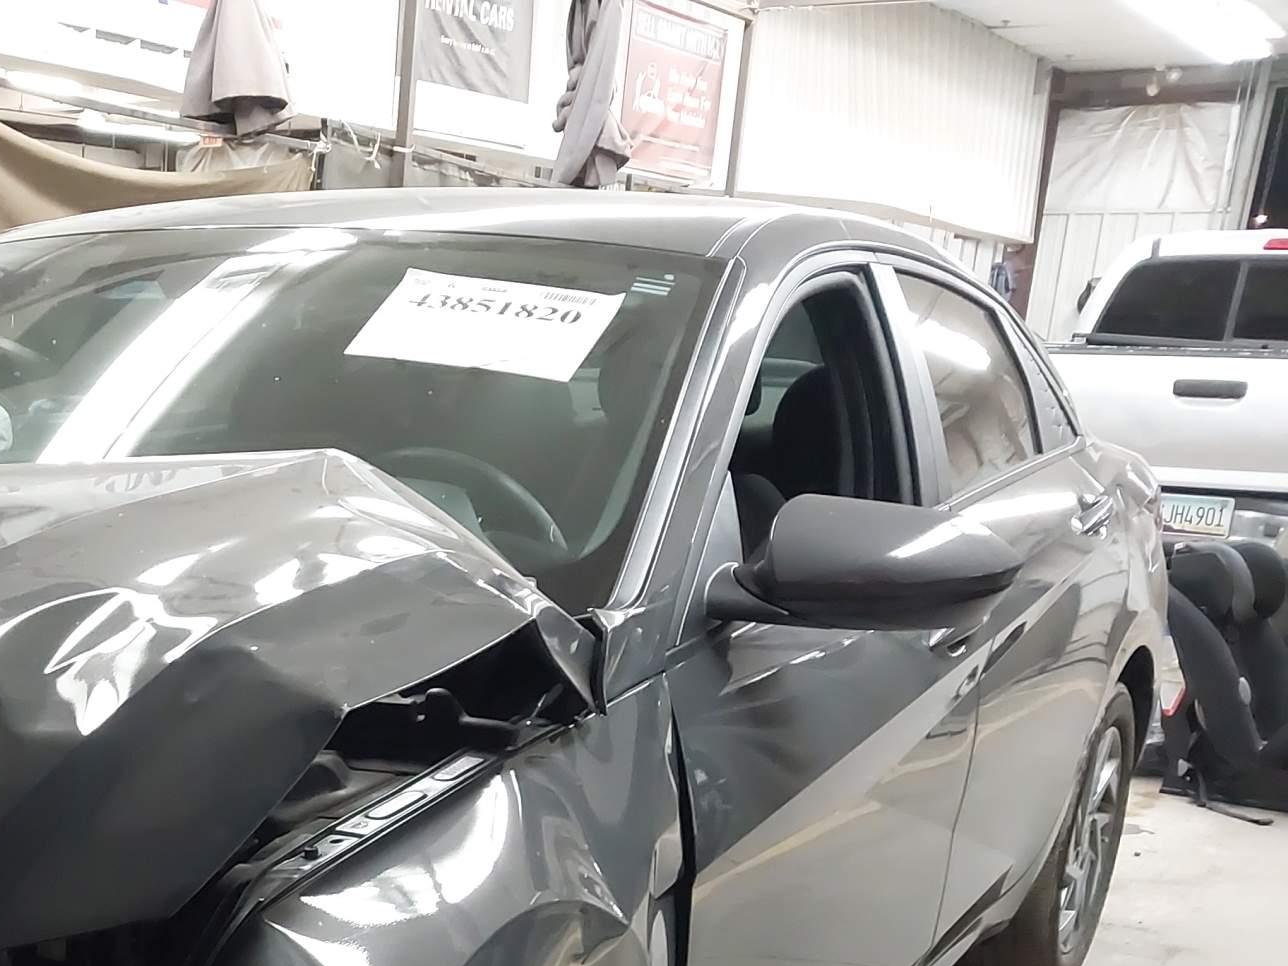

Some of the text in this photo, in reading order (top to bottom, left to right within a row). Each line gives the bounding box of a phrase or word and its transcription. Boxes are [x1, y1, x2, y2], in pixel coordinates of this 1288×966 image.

[480, 1, 514, 31] CARS
[408, 292, 582, 324] 43851820
[1162, 504, 1225, 527] JH4901
